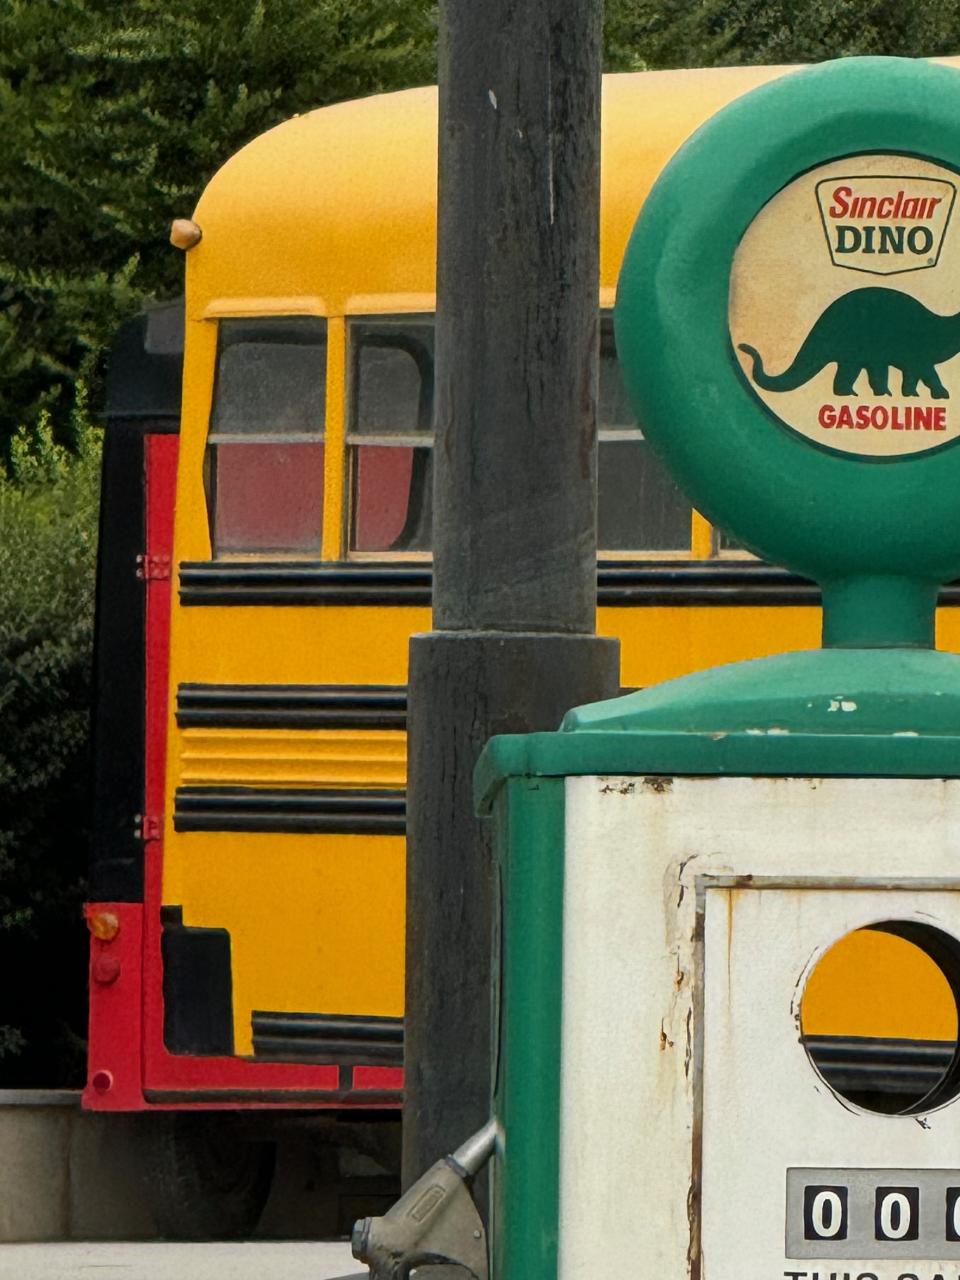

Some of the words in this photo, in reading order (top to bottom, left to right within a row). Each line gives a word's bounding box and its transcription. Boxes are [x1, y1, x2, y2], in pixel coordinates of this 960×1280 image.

[829, 186, 942, 219] Sinclair
[834, 225, 934, 255] DINO
[818, 404, 947, 431] GASOLINE
